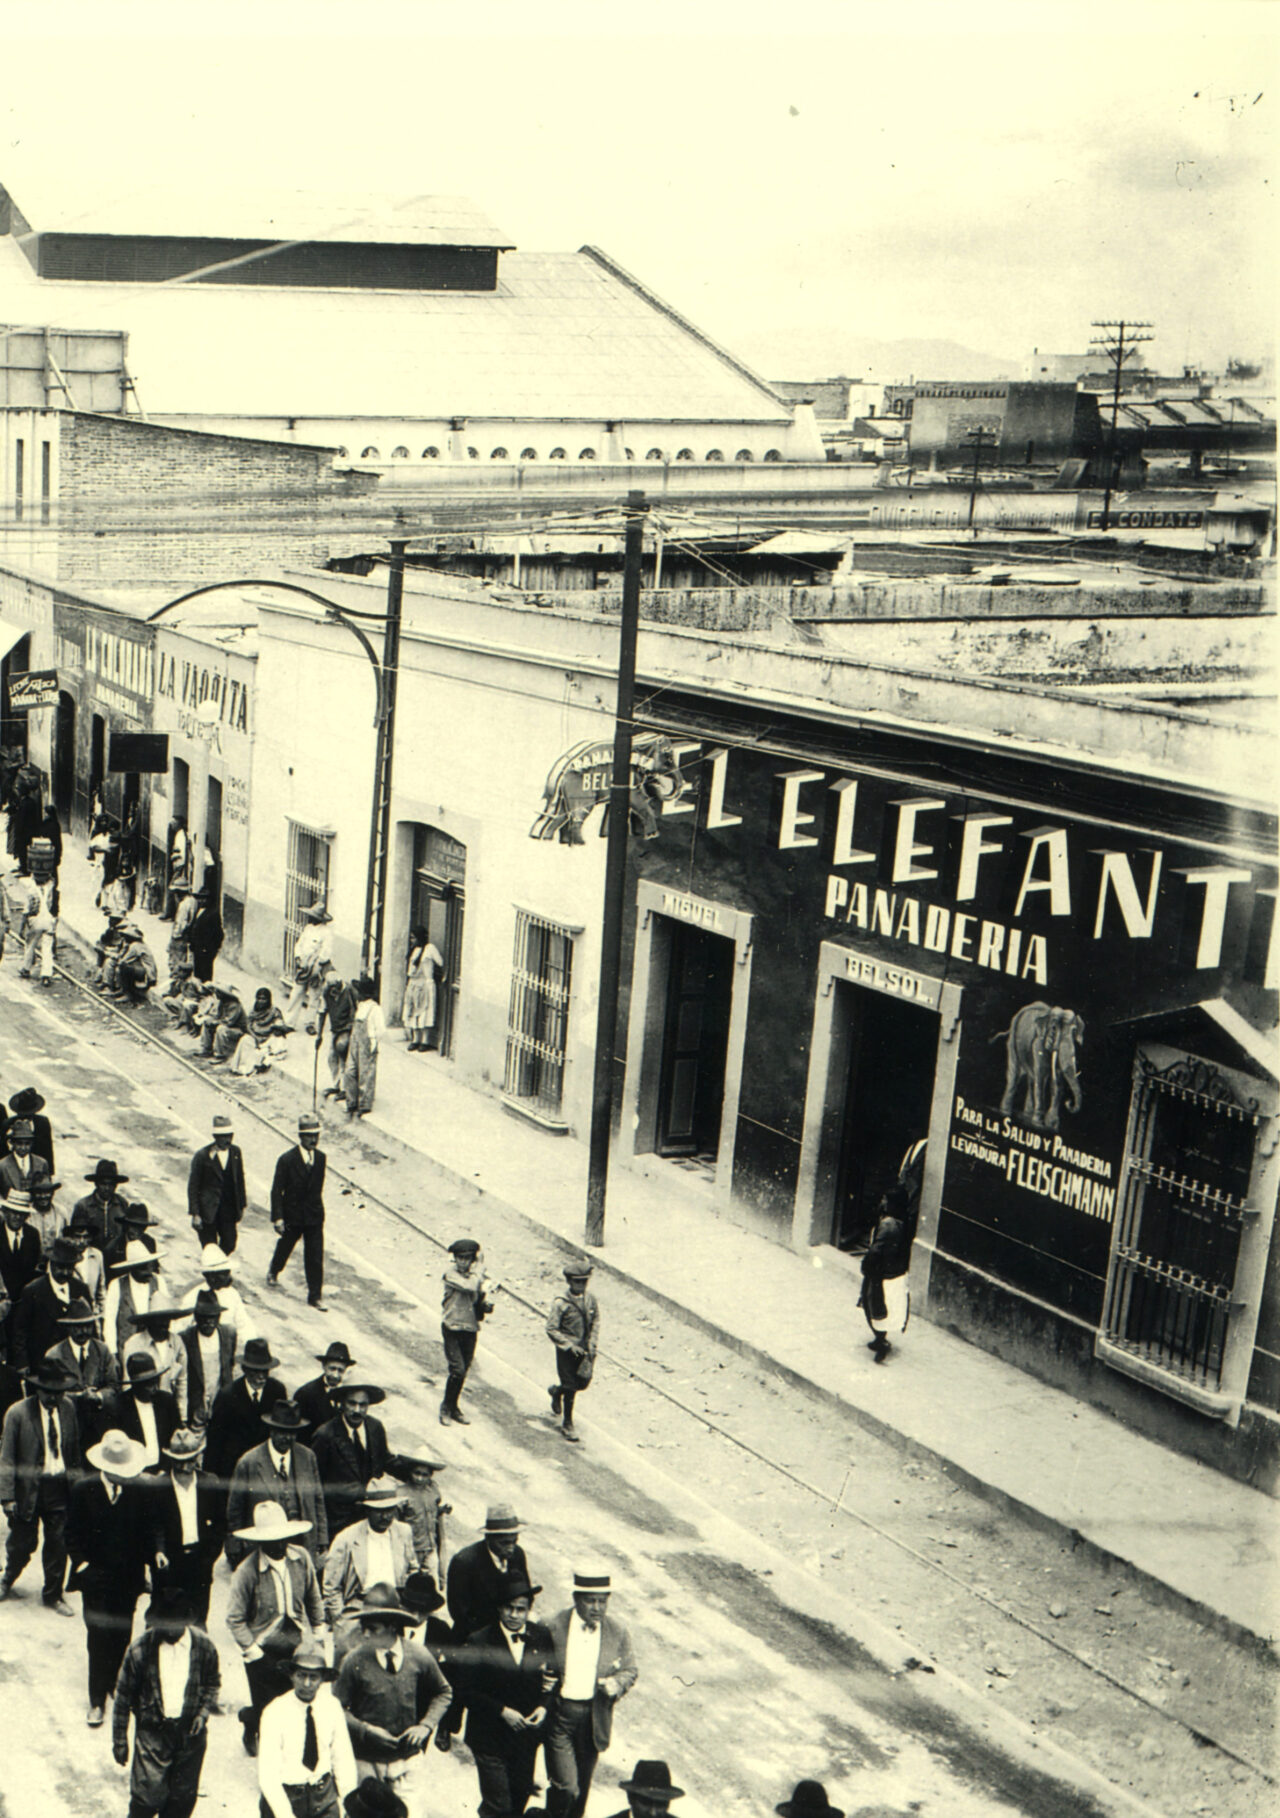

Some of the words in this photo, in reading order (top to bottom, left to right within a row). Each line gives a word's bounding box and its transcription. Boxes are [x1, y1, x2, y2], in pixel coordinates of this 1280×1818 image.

[158, 651, 176, 699] LA
[582, 771, 636, 791] BELL
[658, 743, 743, 829] EL
[663, 893, 725, 931] MIGUEL
[824, 874, 1048, 987] PANADERIA
[951, 1134, 1007, 1170] LEVADURA
[1006, 1148, 1116, 1224] FLEISCHMANN
